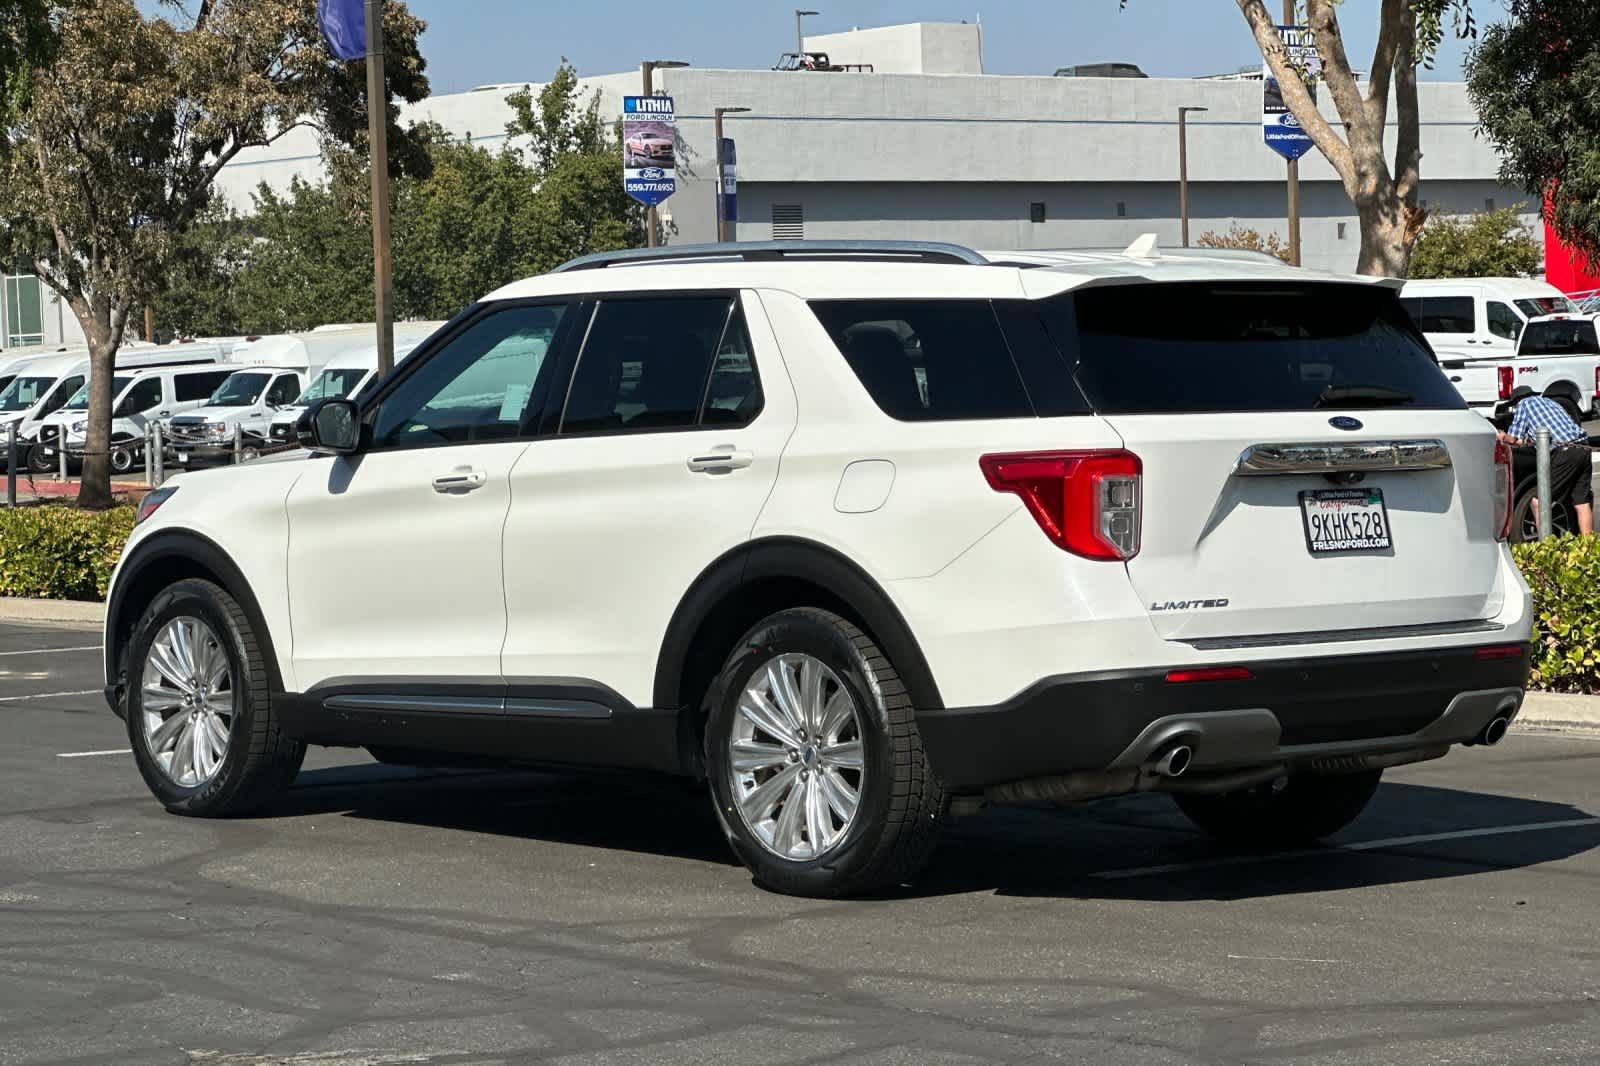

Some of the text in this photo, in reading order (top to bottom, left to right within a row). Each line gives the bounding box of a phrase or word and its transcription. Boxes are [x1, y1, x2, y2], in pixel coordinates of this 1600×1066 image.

[635, 99, 673, 113] LITHIA
[643, 168, 663, 179] Ford
[627, 183, 674, 192] 559.777.6952
[1311, 512, 1383, 541] 9KHK528
[1312, 537, 1389, 551] FRESNOFORD.COM
[1150, 598, 1229, 611] LIMITED
